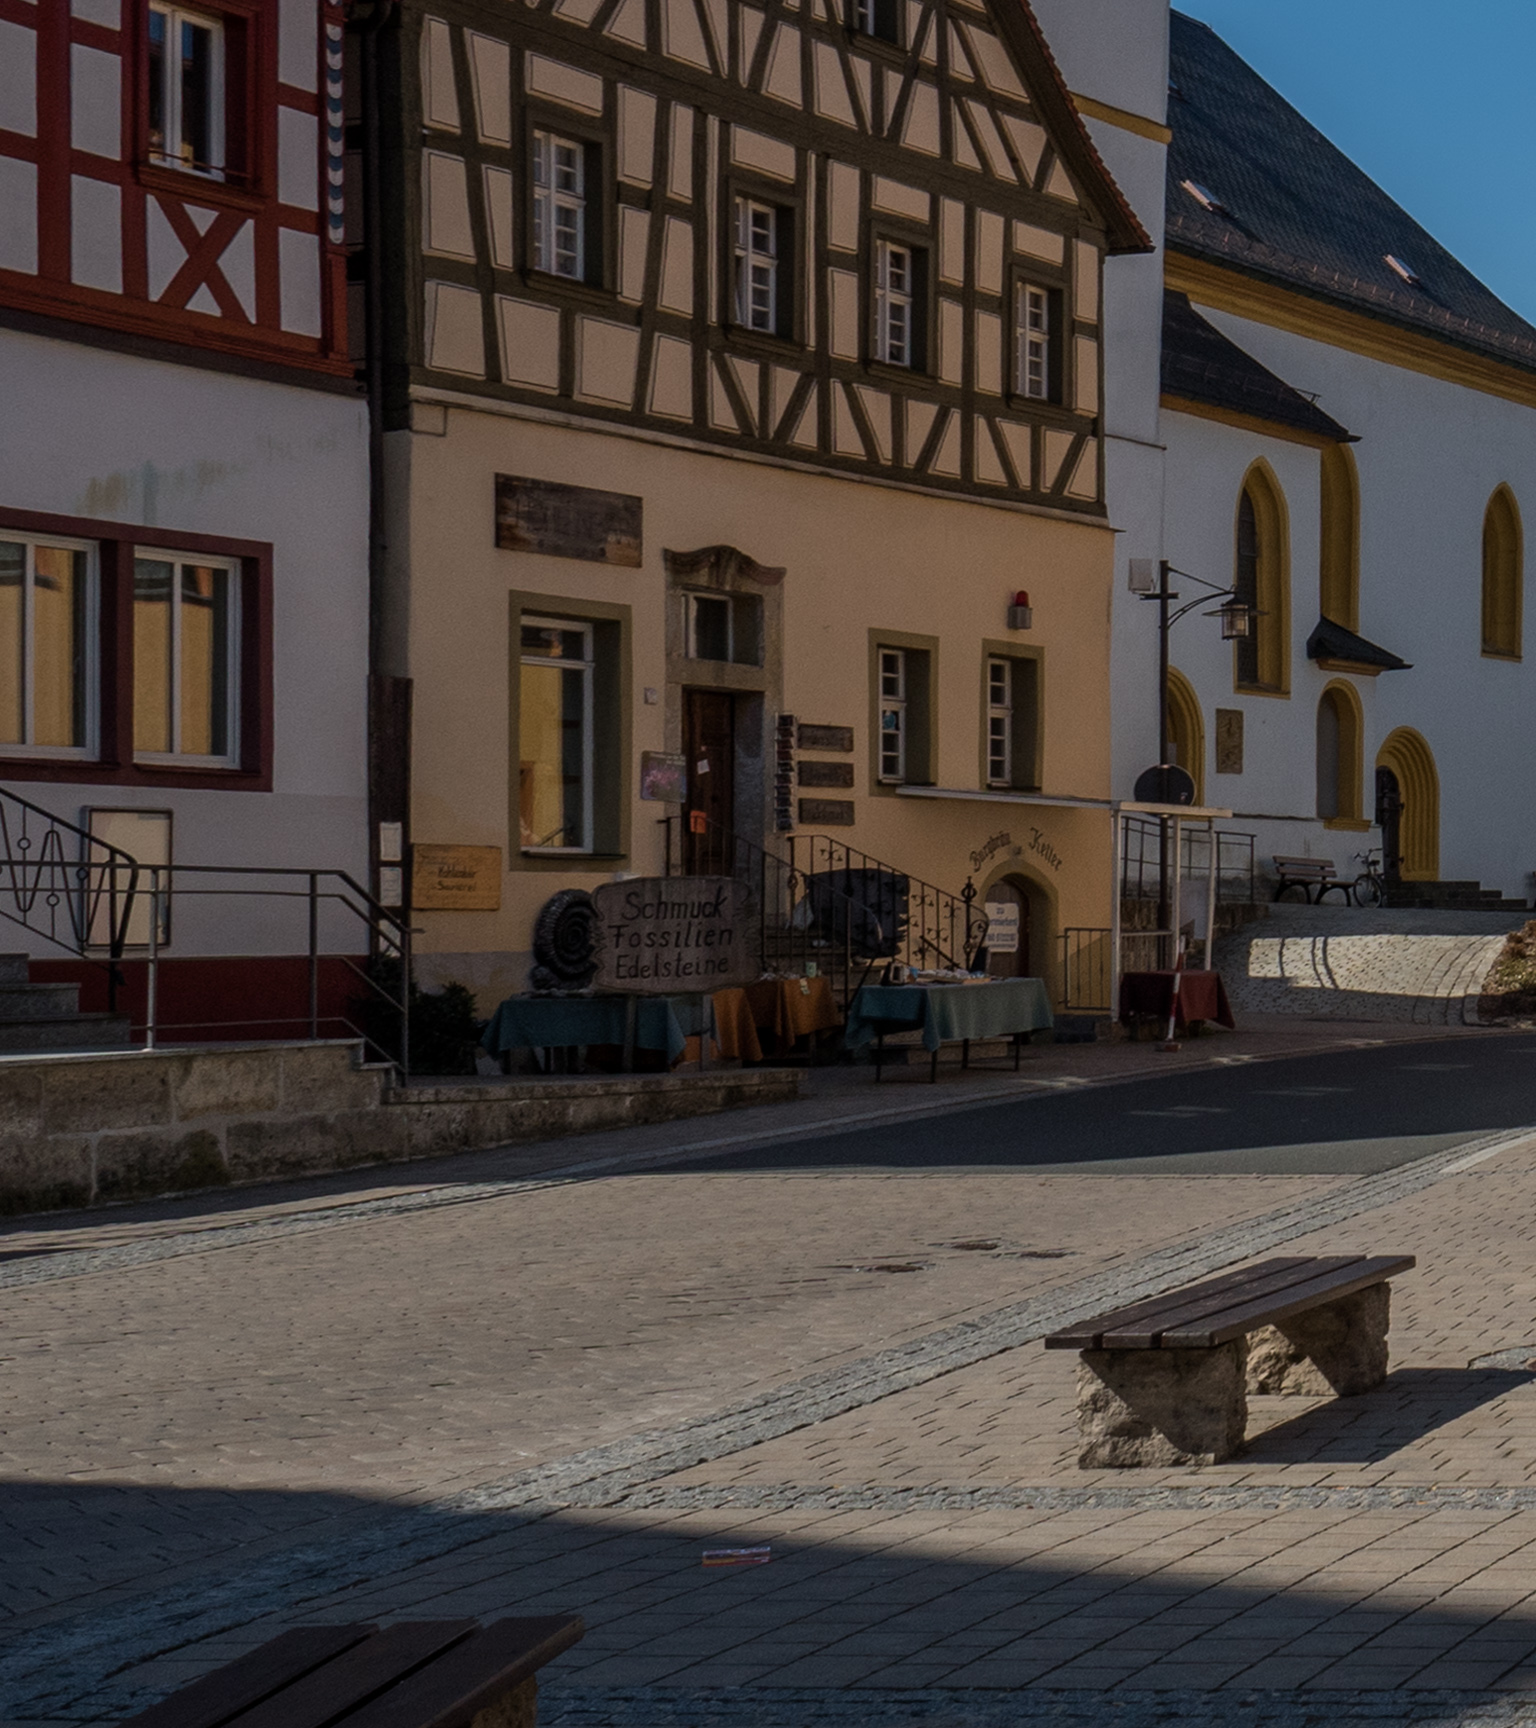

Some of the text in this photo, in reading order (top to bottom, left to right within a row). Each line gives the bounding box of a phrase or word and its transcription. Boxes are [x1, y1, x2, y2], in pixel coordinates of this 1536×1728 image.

[1029, 826, 1063, 872] Keller
[623, 884, 728, 921] Schmuck
[608, 921, 733, 949] Fossilien
[616, 952, 729, 980] Edelsteine
